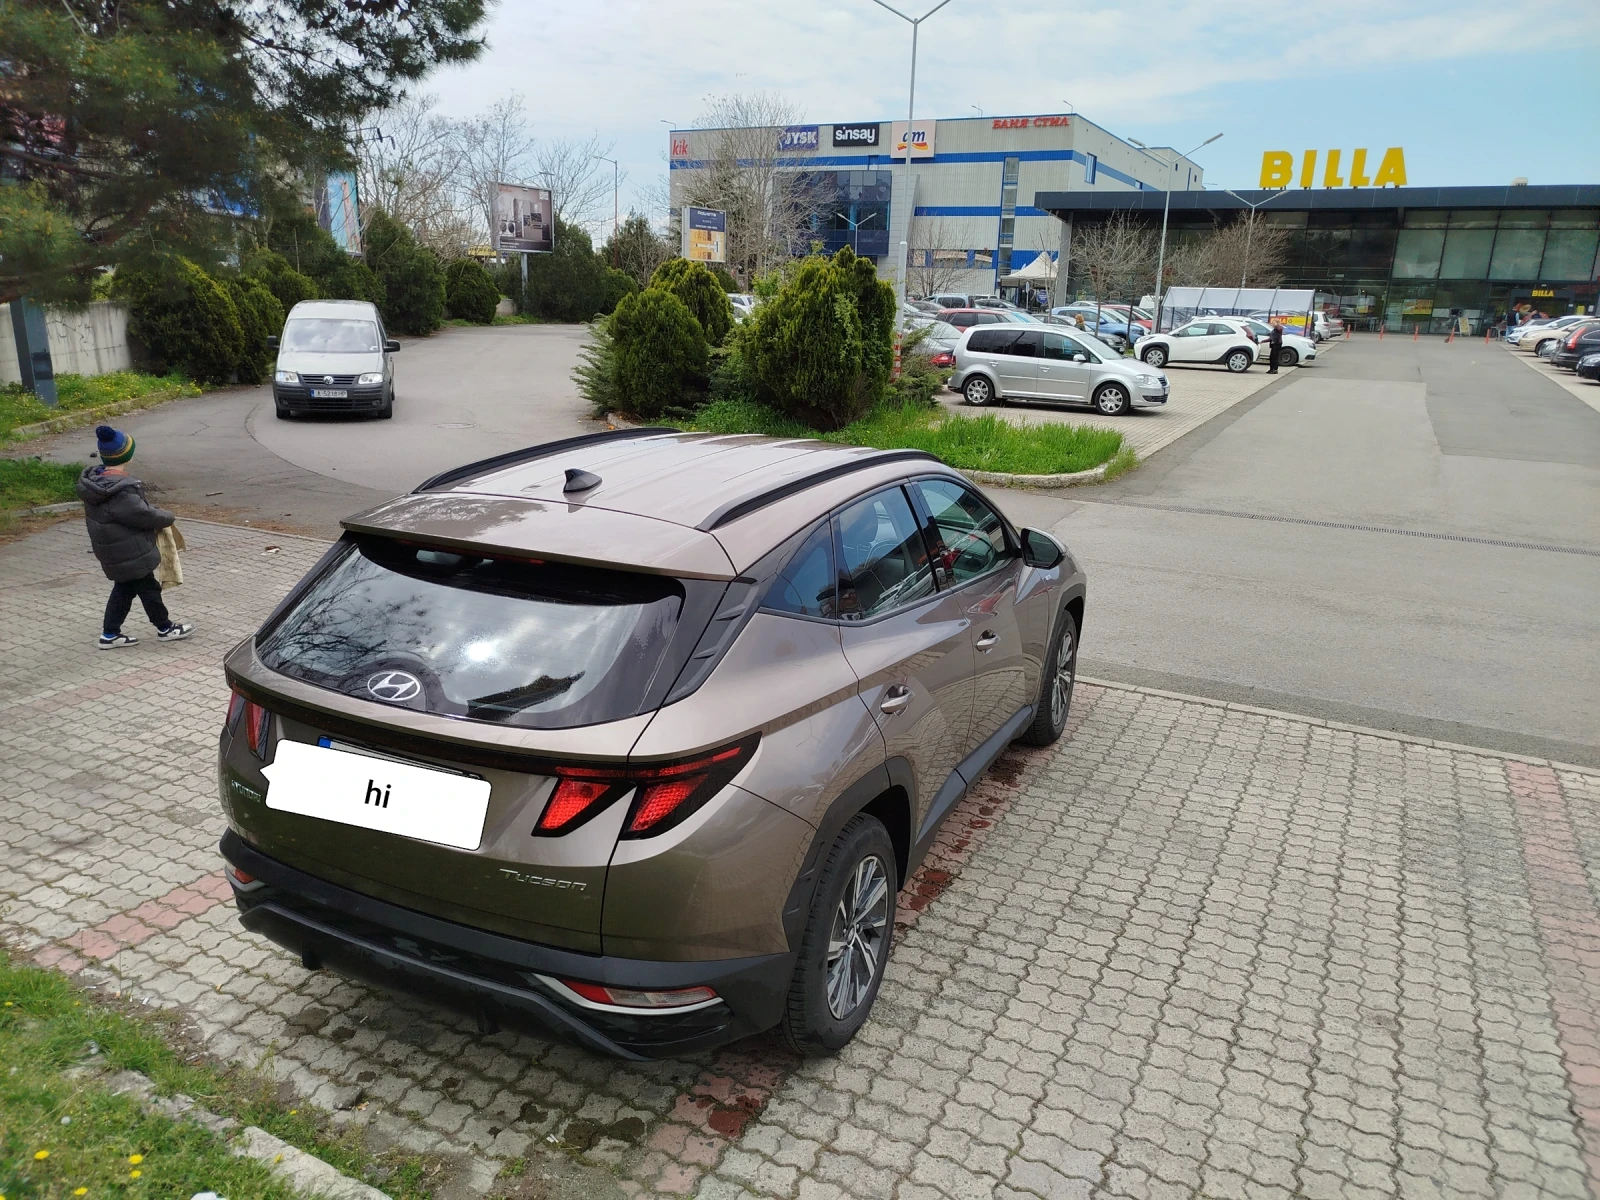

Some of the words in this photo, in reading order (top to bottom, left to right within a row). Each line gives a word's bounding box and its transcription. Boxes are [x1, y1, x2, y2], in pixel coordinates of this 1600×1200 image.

[785, 132, 817, 145] JYSK
[835, 126, 876, 143] sinsay
[1259, 147, 1408, 188] BILLA
